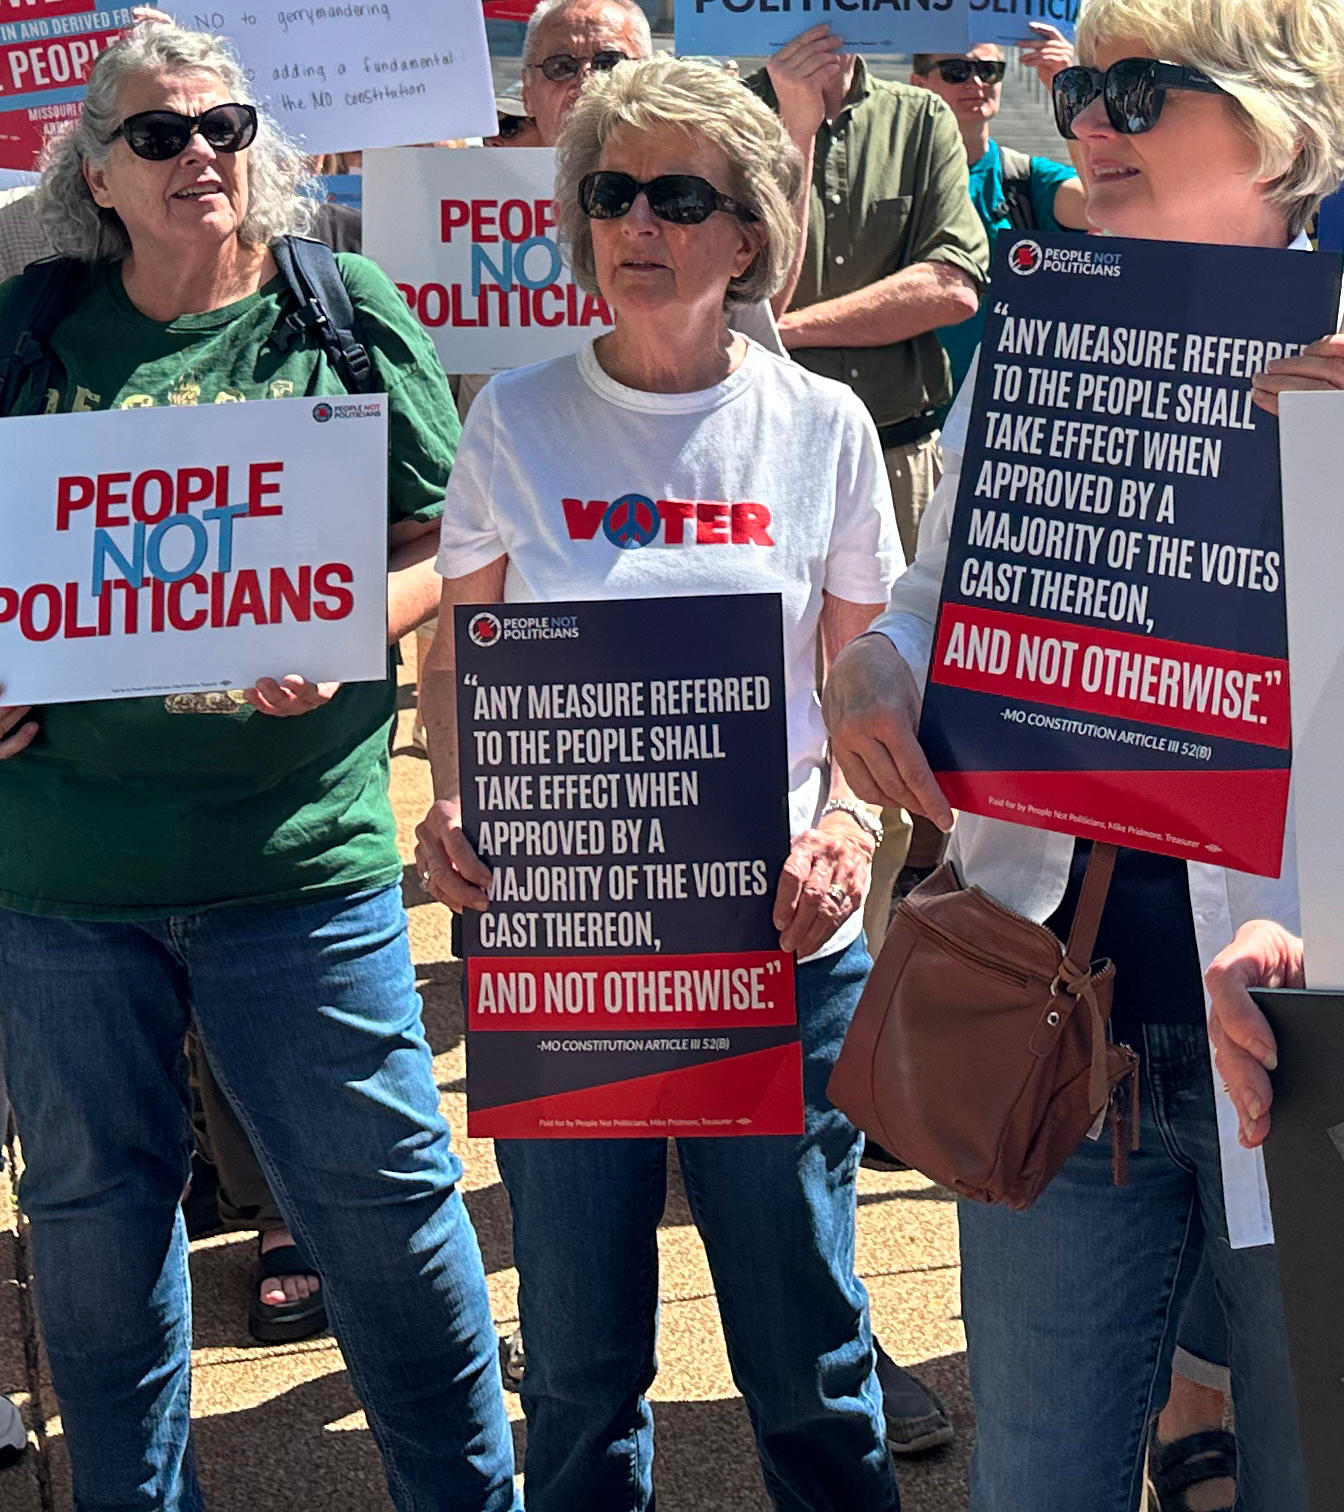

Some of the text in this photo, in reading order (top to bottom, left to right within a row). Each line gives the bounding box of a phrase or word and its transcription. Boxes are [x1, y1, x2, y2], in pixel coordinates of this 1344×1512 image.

[20, 21, 49, 39] AND
[51, 11, 110, 36] DERIVED
[194, 3, 391, 33] NO to gerrymandering
[272, 51, 454, 81] adding fundamental
[282, 95, 305, 112] the
[311, 92, 332, 109] MO
[441, 199, 560, 243] PEOP
[1042, 259, 1122, 277] POLITICIANS
[1044, 248, 1122, 265] PEOPLE NOT
[395, 283, 616, 327] OLITICIA
[1055, 322, 1178, 371] MEASURE
[334, 403, 381, 414] PEOPLE NOT
[334, 409, 381, 420] POLITICIANS
[992, 364, 1256, 431] TO THE PEOPLE SHALL
[985, 412, 1222, 479] TAKE EFFECT WHEN
[56, 462, 284, 531] PEOPLE
[975, 460, 1113, 515] APPROVED
[562, 494, 774, 549] VOTER
[92, 502, 250, 597] NOT
[967, 508, 1280, 592] MAJORITY OF THE VOTES
[960, 557, 1156, 634] CAST THEREON,
[503, 616, 577, 630] PEOPLE NOT
[503, 627, 579, 641] POLITICIANS
[944, 622, 1007, 675] AND
[1015, 632, 1079, 687] NOT
[527, 675, 770, 720] MEASURE REFERRED
[473, 723, 725, 766] TO THE PEOPLE SHALL
[1027, 713, 1117, 741] CONSTITUTION
[1117, 730, 1166, 751] ARTICLE
[475, 770, 698, 812] TAKE EFFECT WHEN
[1028, 804, 1052, 818] People
[477, 819, 606, 856] APPROVED
[608, 863, 637, 900] OF
[640, 861, 688, 900] THE
[693, 860, 767, 897] VOTES
[479, 909, 663, 952] CAST THEREON,
[476, 972, 536, 1016] AND
[542, 970, 598, 1014] NOT
[562, 1040, 644, 1052] CONSTITUTION
[644, 1039, 689, 1051] ARTICLE
